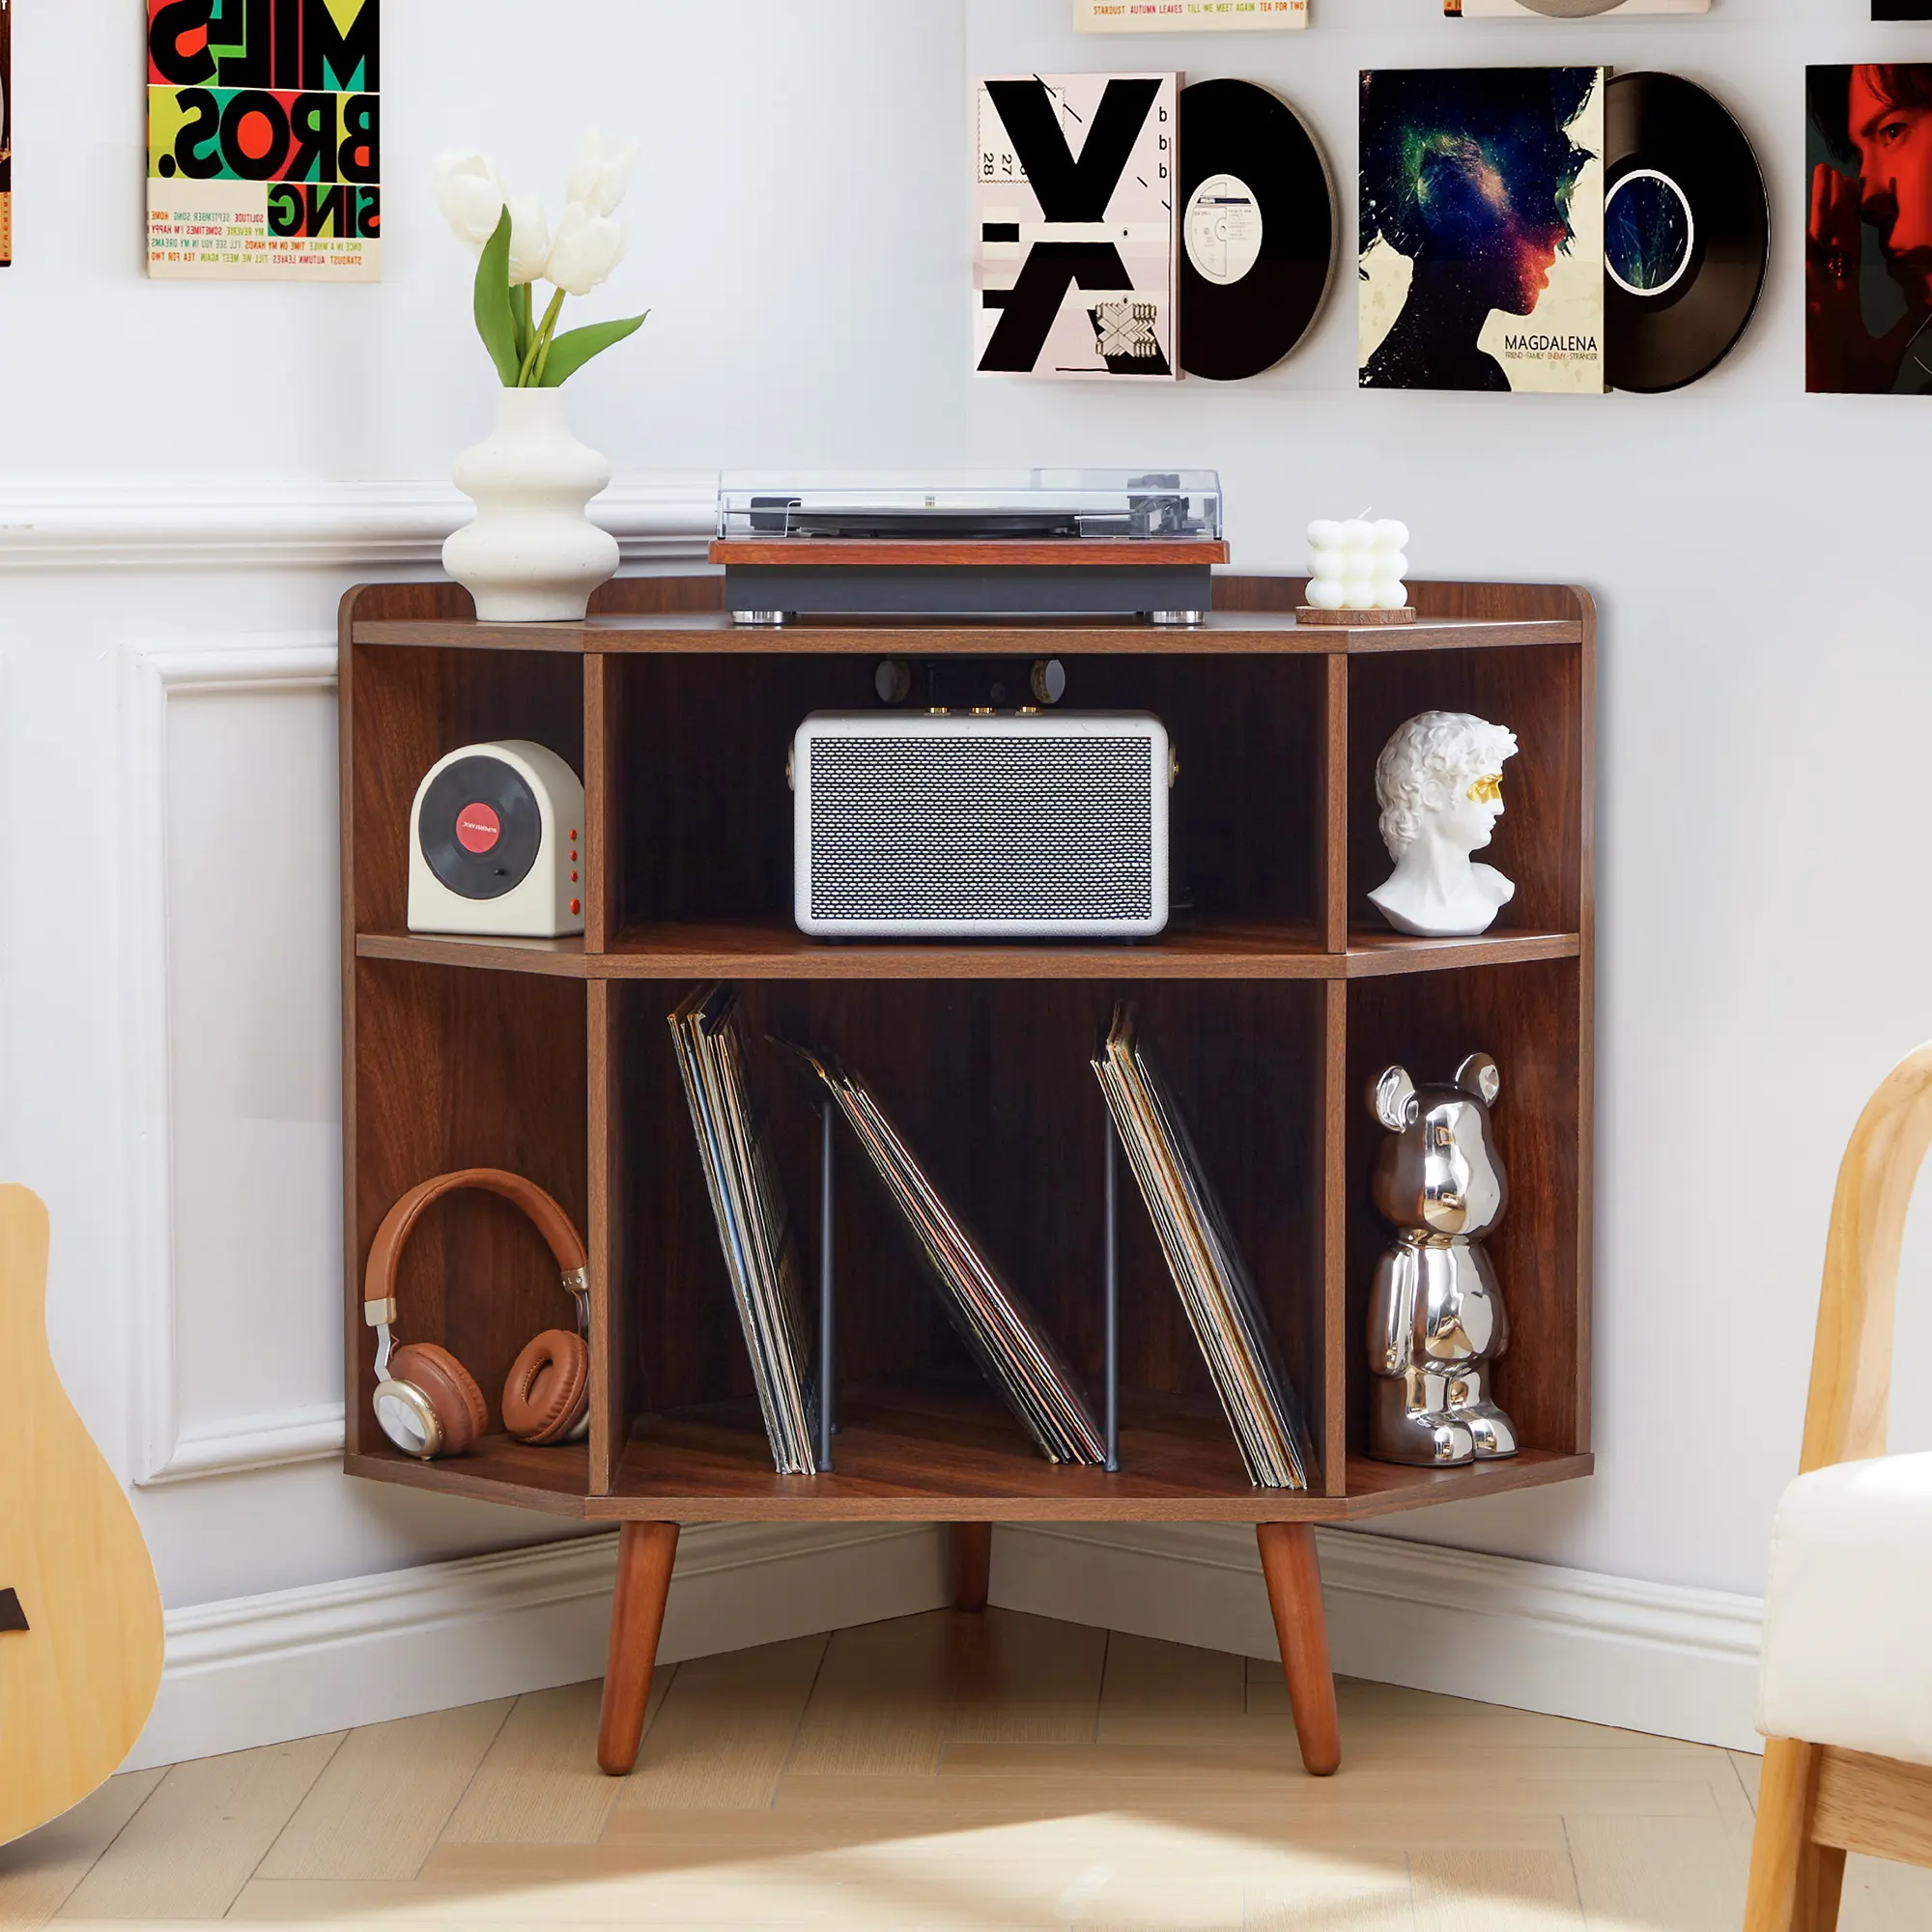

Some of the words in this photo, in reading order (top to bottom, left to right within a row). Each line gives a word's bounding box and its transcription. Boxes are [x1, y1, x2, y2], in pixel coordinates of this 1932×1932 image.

[1094, 6, 1124, 15] STARDUST
[1130, 5, 1155, 14] AUTUMN
[1159, 5, 1182, 14] LEAVES
[1187, 4, 1201, 13] TILL
[1260, 2, 1271, 12] TEA
[1275, 2, 1287, 12] FOR
[1291, 2, 1304, 11] TWO
[983, 153, 994, 175] 28
[1002, 154, 1012, 175] 27
[1505, 335, 1598, 352] MAGDALENA
[1570, 353, 1598, 361] STRANGER
